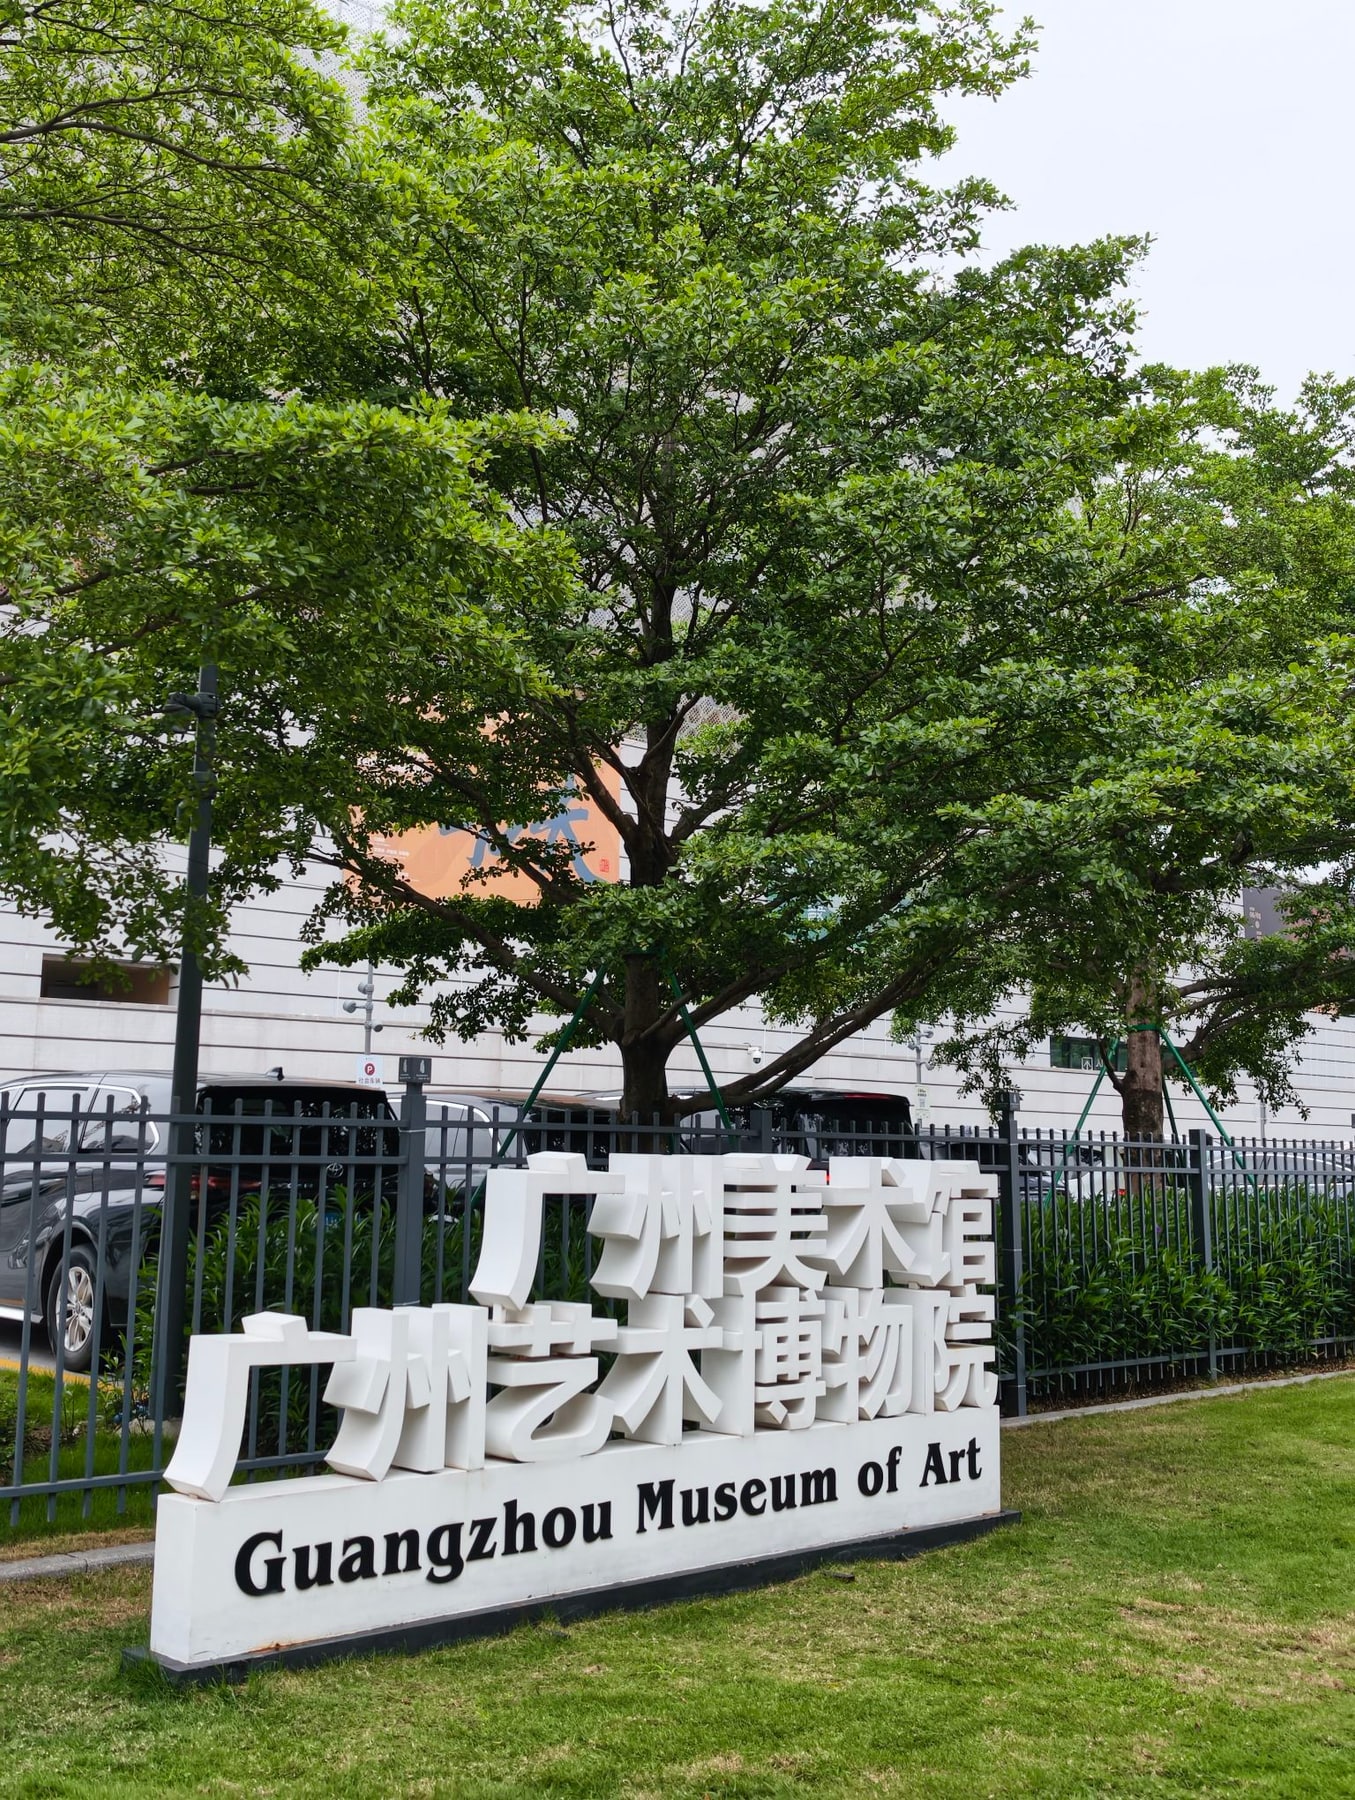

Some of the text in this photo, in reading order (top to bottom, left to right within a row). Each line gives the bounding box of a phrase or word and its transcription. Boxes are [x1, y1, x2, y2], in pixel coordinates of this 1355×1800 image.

[468, 1151, 998, 1311] 广州美术馆
[163, 1283, 998, 1502] 广州艺术博物院
[234, 1437, 983, 1597] Guangzhou Museum of Art
